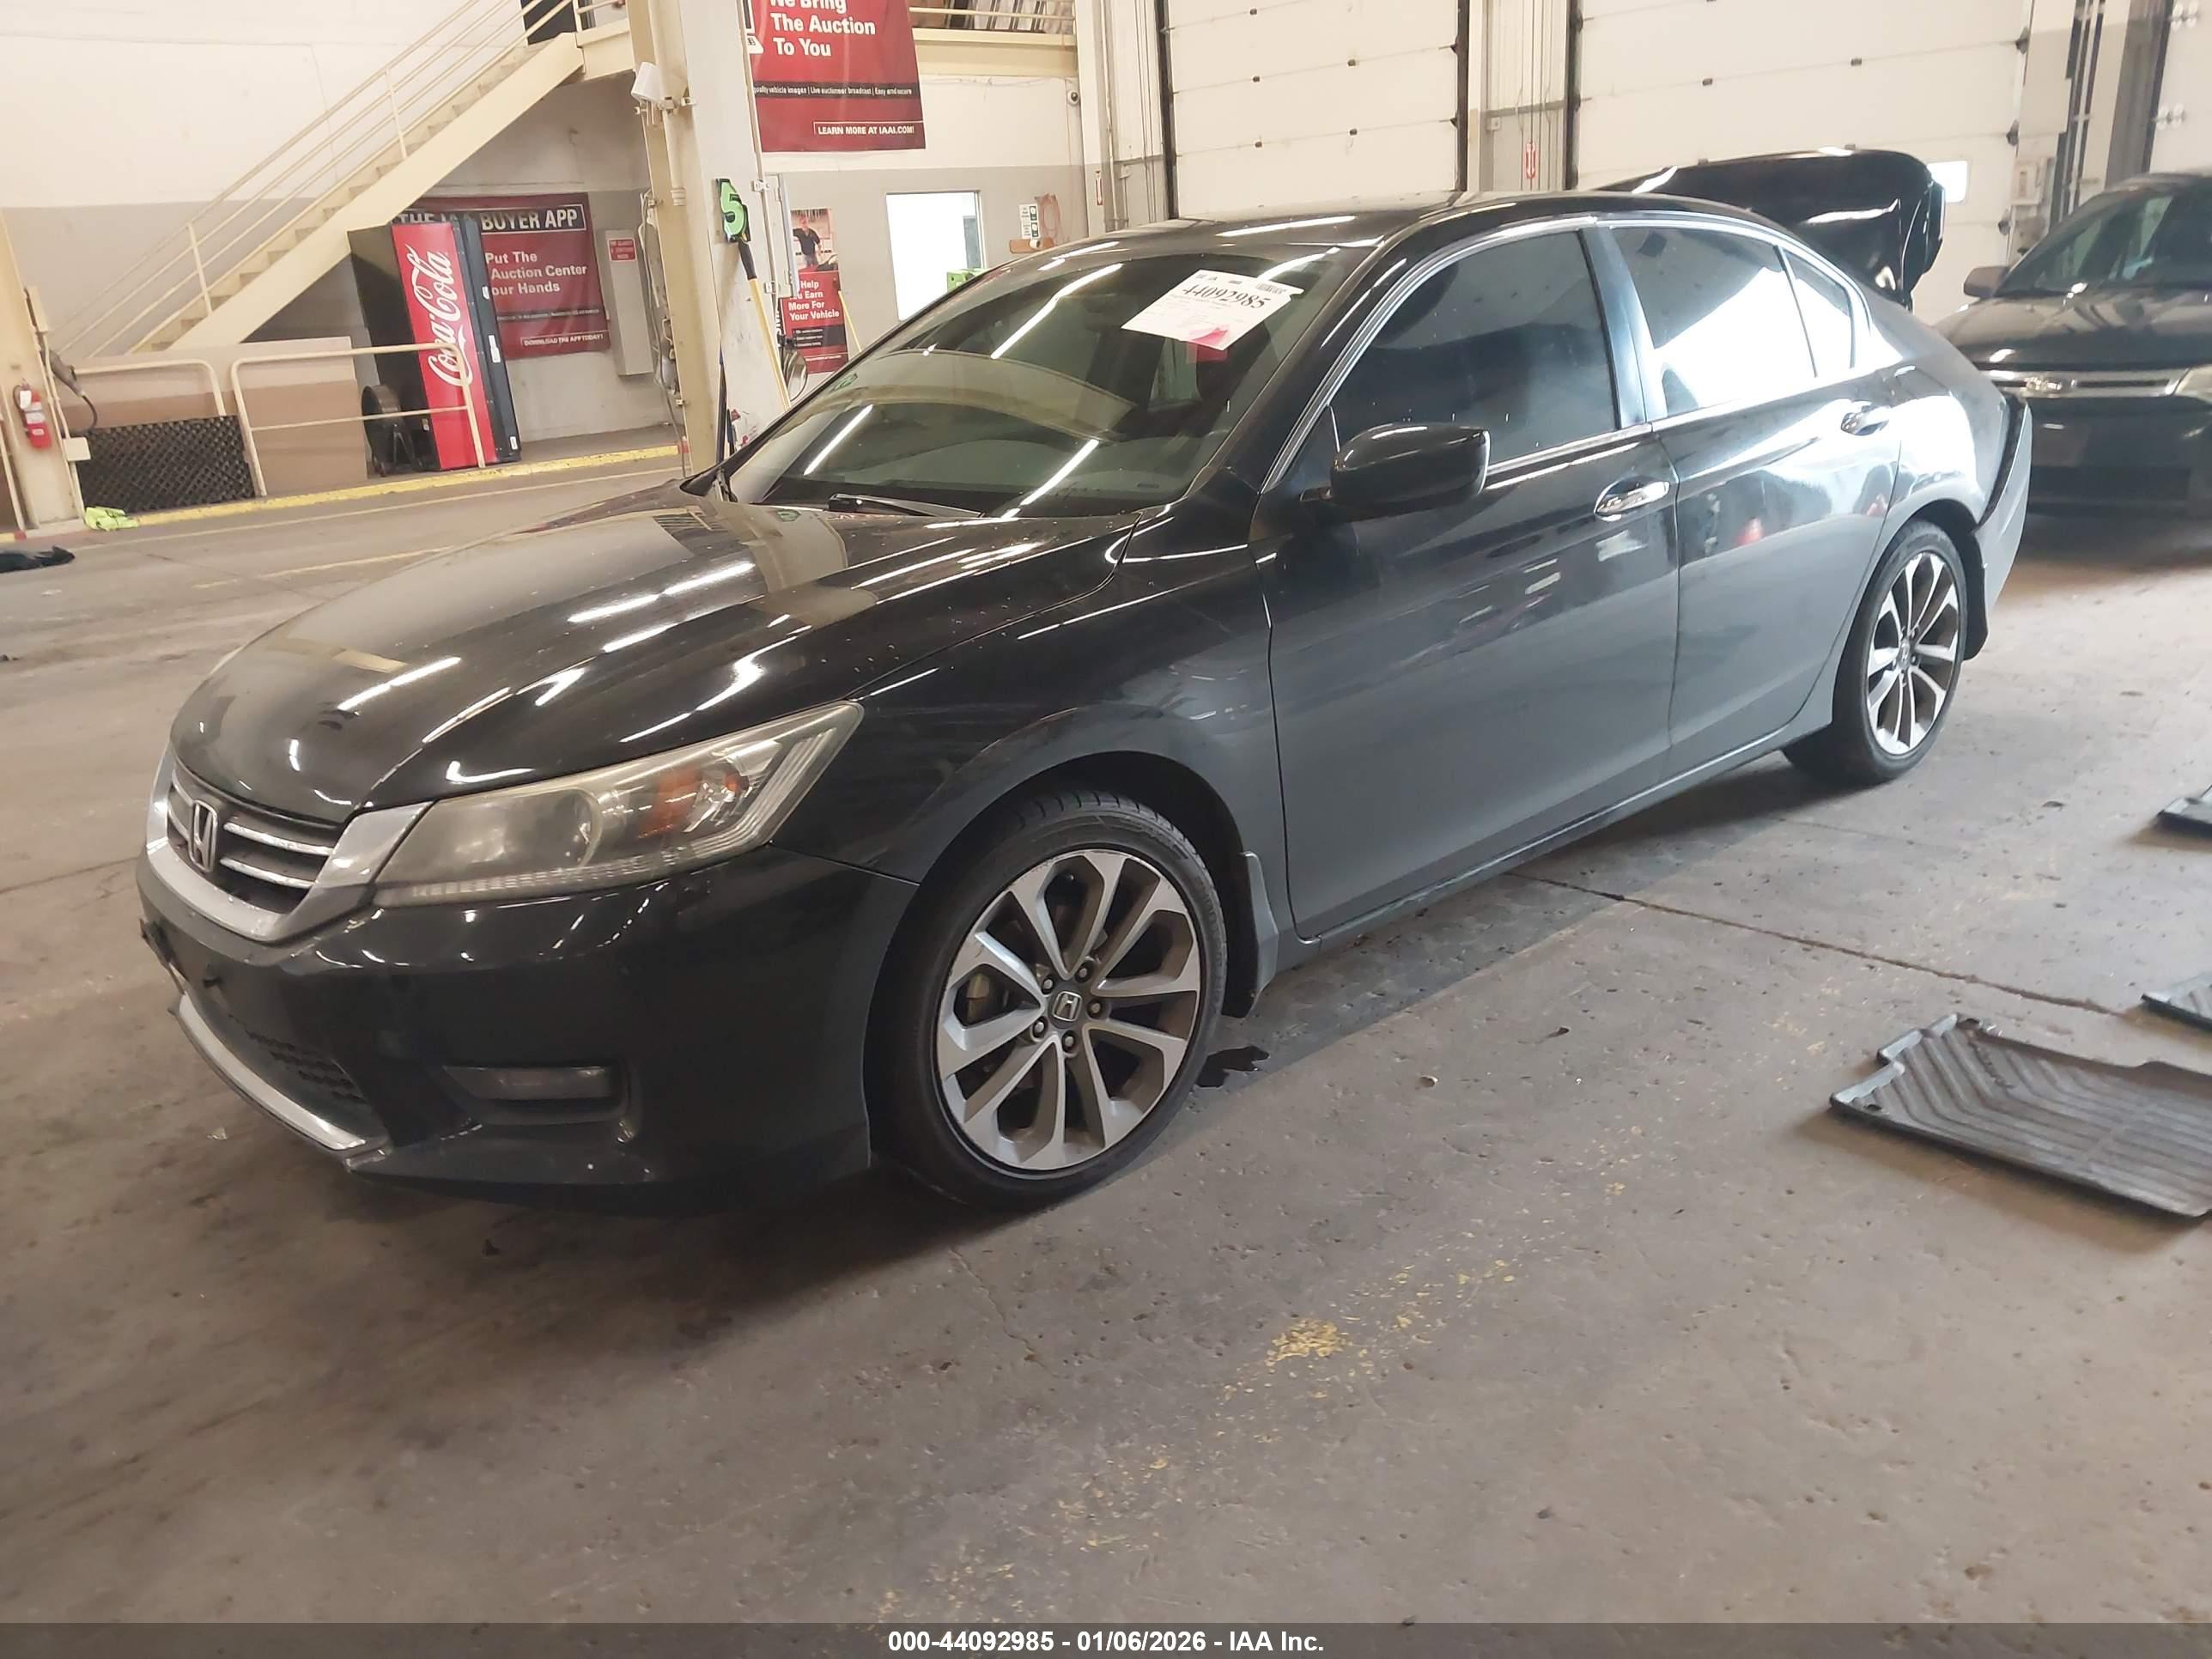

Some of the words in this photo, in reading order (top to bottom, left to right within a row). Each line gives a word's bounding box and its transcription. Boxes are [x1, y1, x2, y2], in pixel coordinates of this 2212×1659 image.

[770, 13, 804, 32] The
[809, 15, 876, 35] Auction
[773, 38, 794, 55] To
[799, 38, 831, 56] You
[817, 126, 843, 135] LEARN
[481, 212, 540, 231] BUYER
[544, 209, 578, 228] APP
[484, 252, 508, 264] Put
[513, 251, 538, 263] The
[491, 267, 542, 280] Auction
[545, 264, 587, 276] Center
[492, 285, 514, 295] our
[518, 281, 561, 295] Hands
[801, 280, 819, 290] Help
[805, 290, 823, 299] Earn
[1183, 284, 1271, 308] 44092985
[788, 302, 810, 311] More
[811, 301, 825, 309] For
[790, 312, 808, 321] Your
[810, 309, 840, 319] Vehicle
